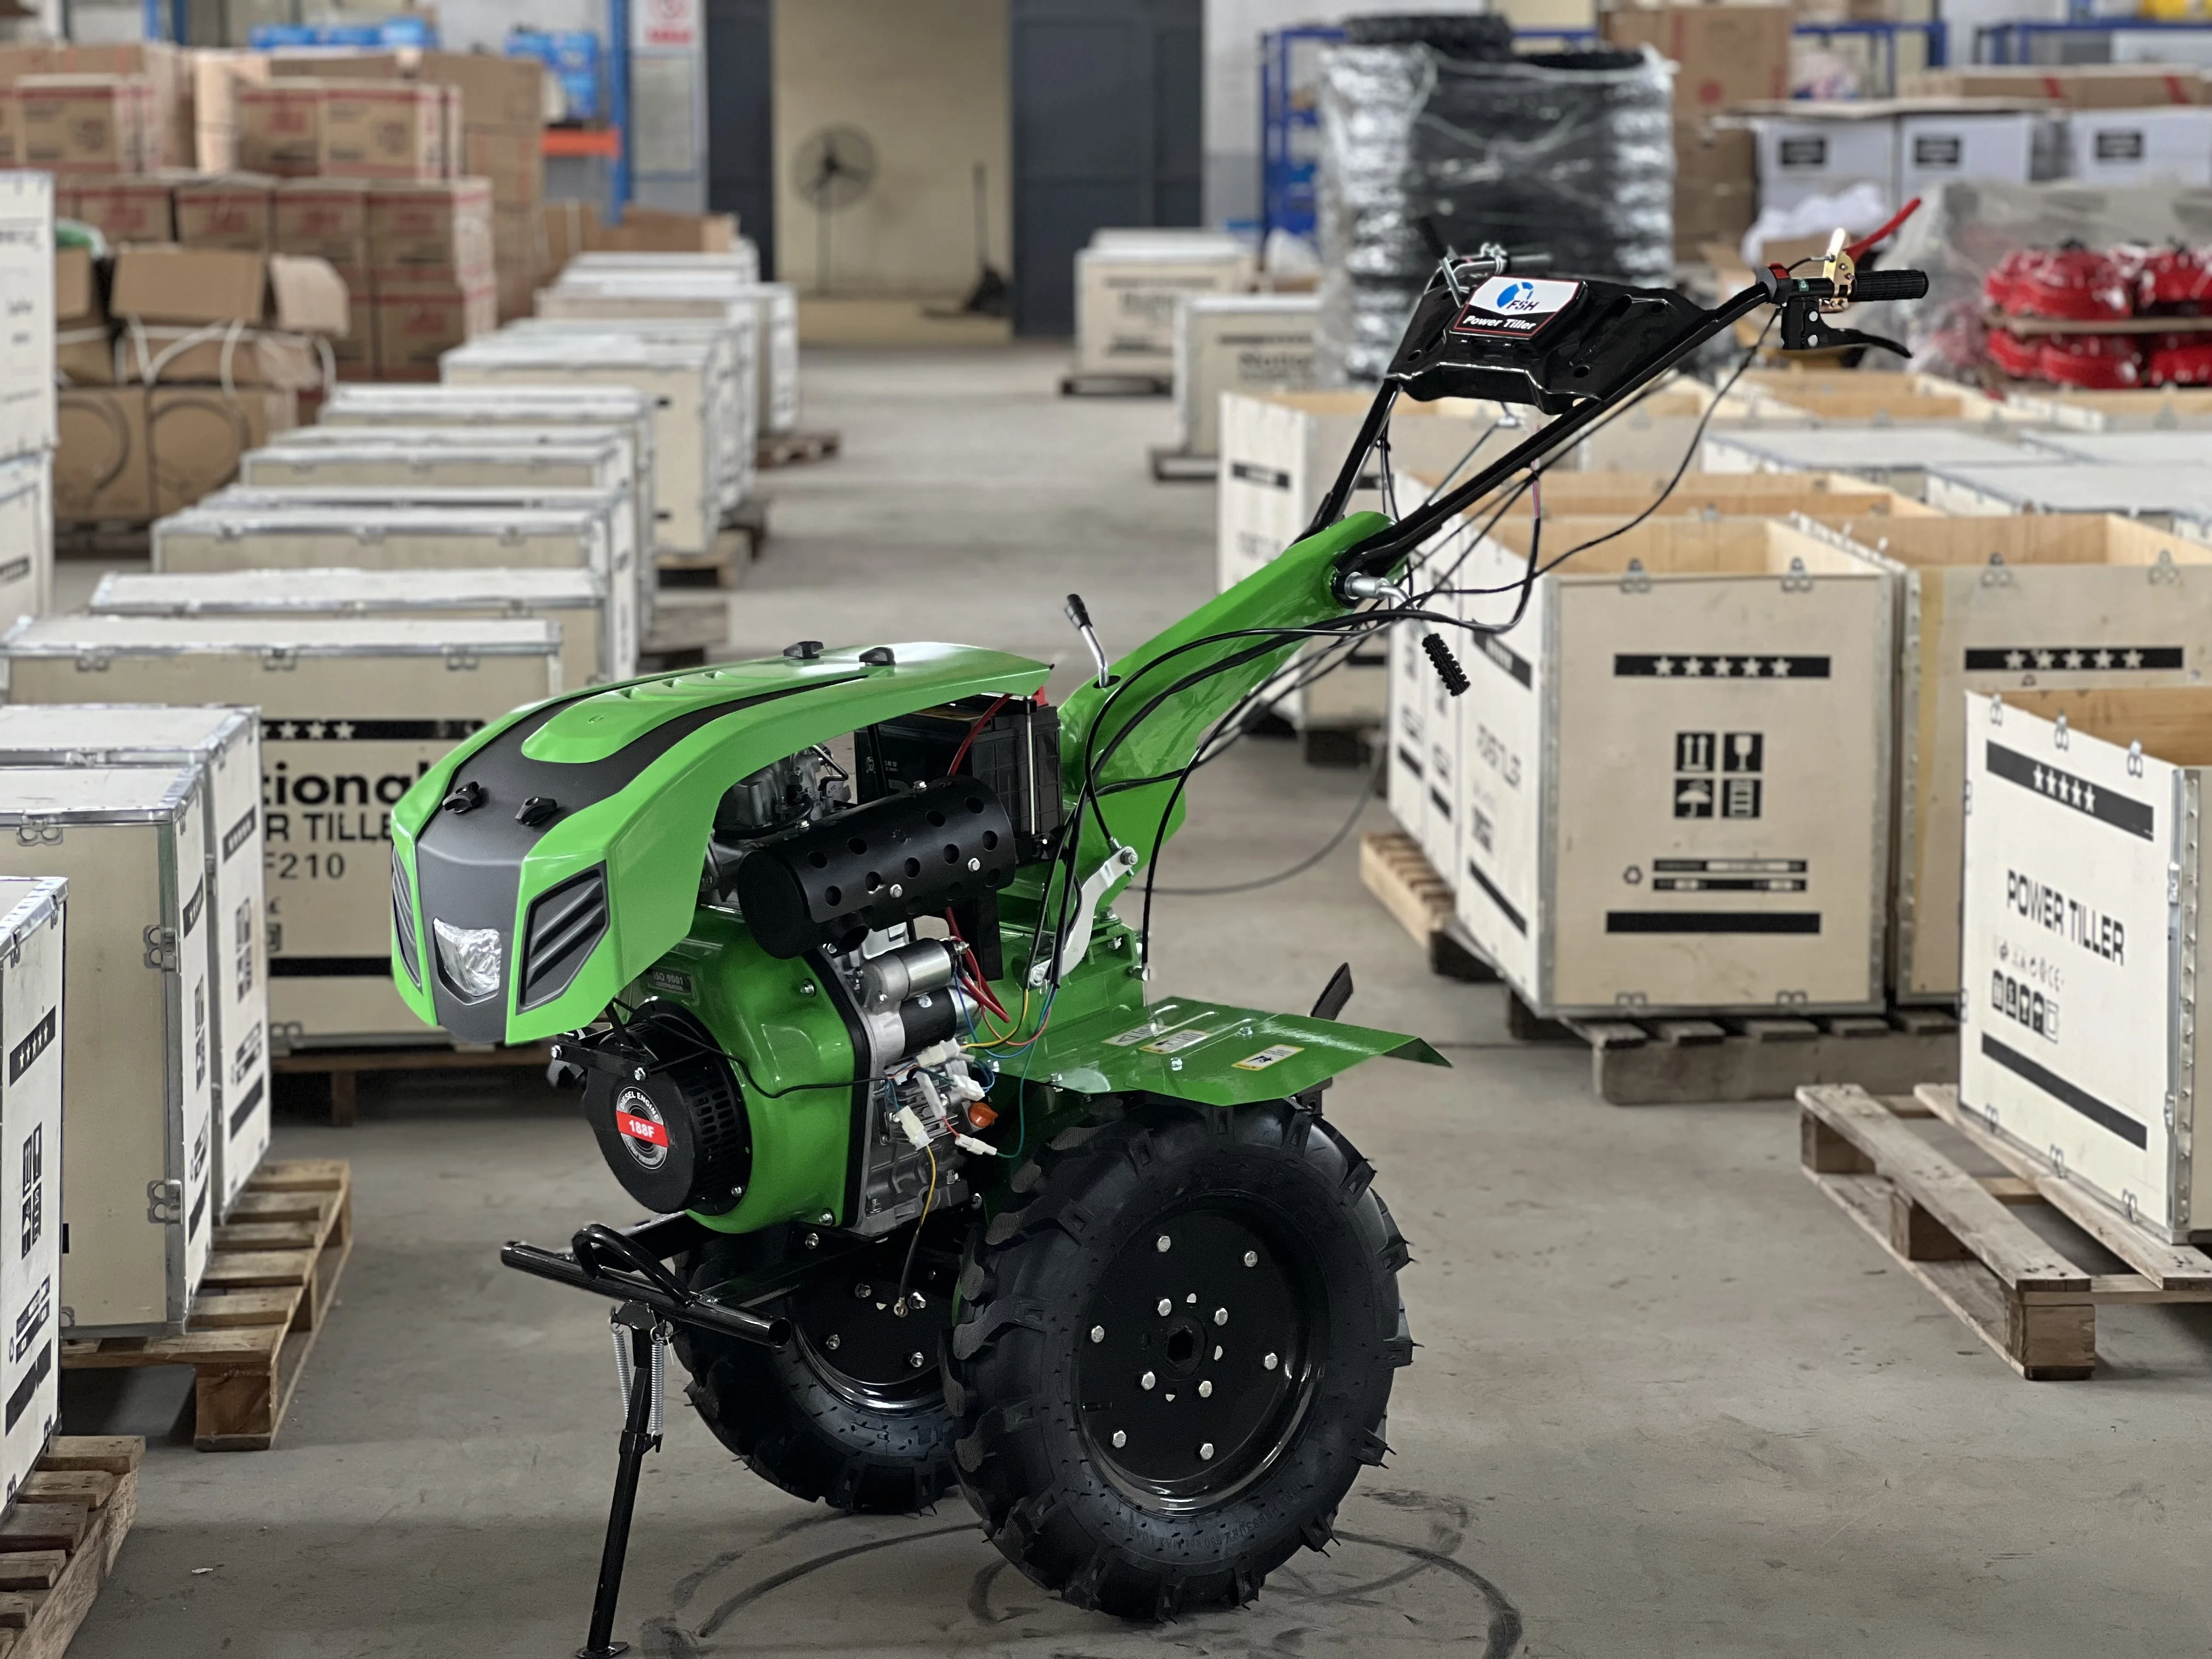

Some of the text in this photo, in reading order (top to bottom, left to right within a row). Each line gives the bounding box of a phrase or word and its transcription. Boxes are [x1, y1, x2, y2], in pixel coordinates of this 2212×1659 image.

[1505, 300, 1540, 311] FSH
[1462, 315, 1537, 330] Power Tiller
[2006, 868, 2124, 967] POWER TILLER
[619, 1091, 660, 1121] DIESEL ENGINE
[629, 1120, 654, 1138] 188F
